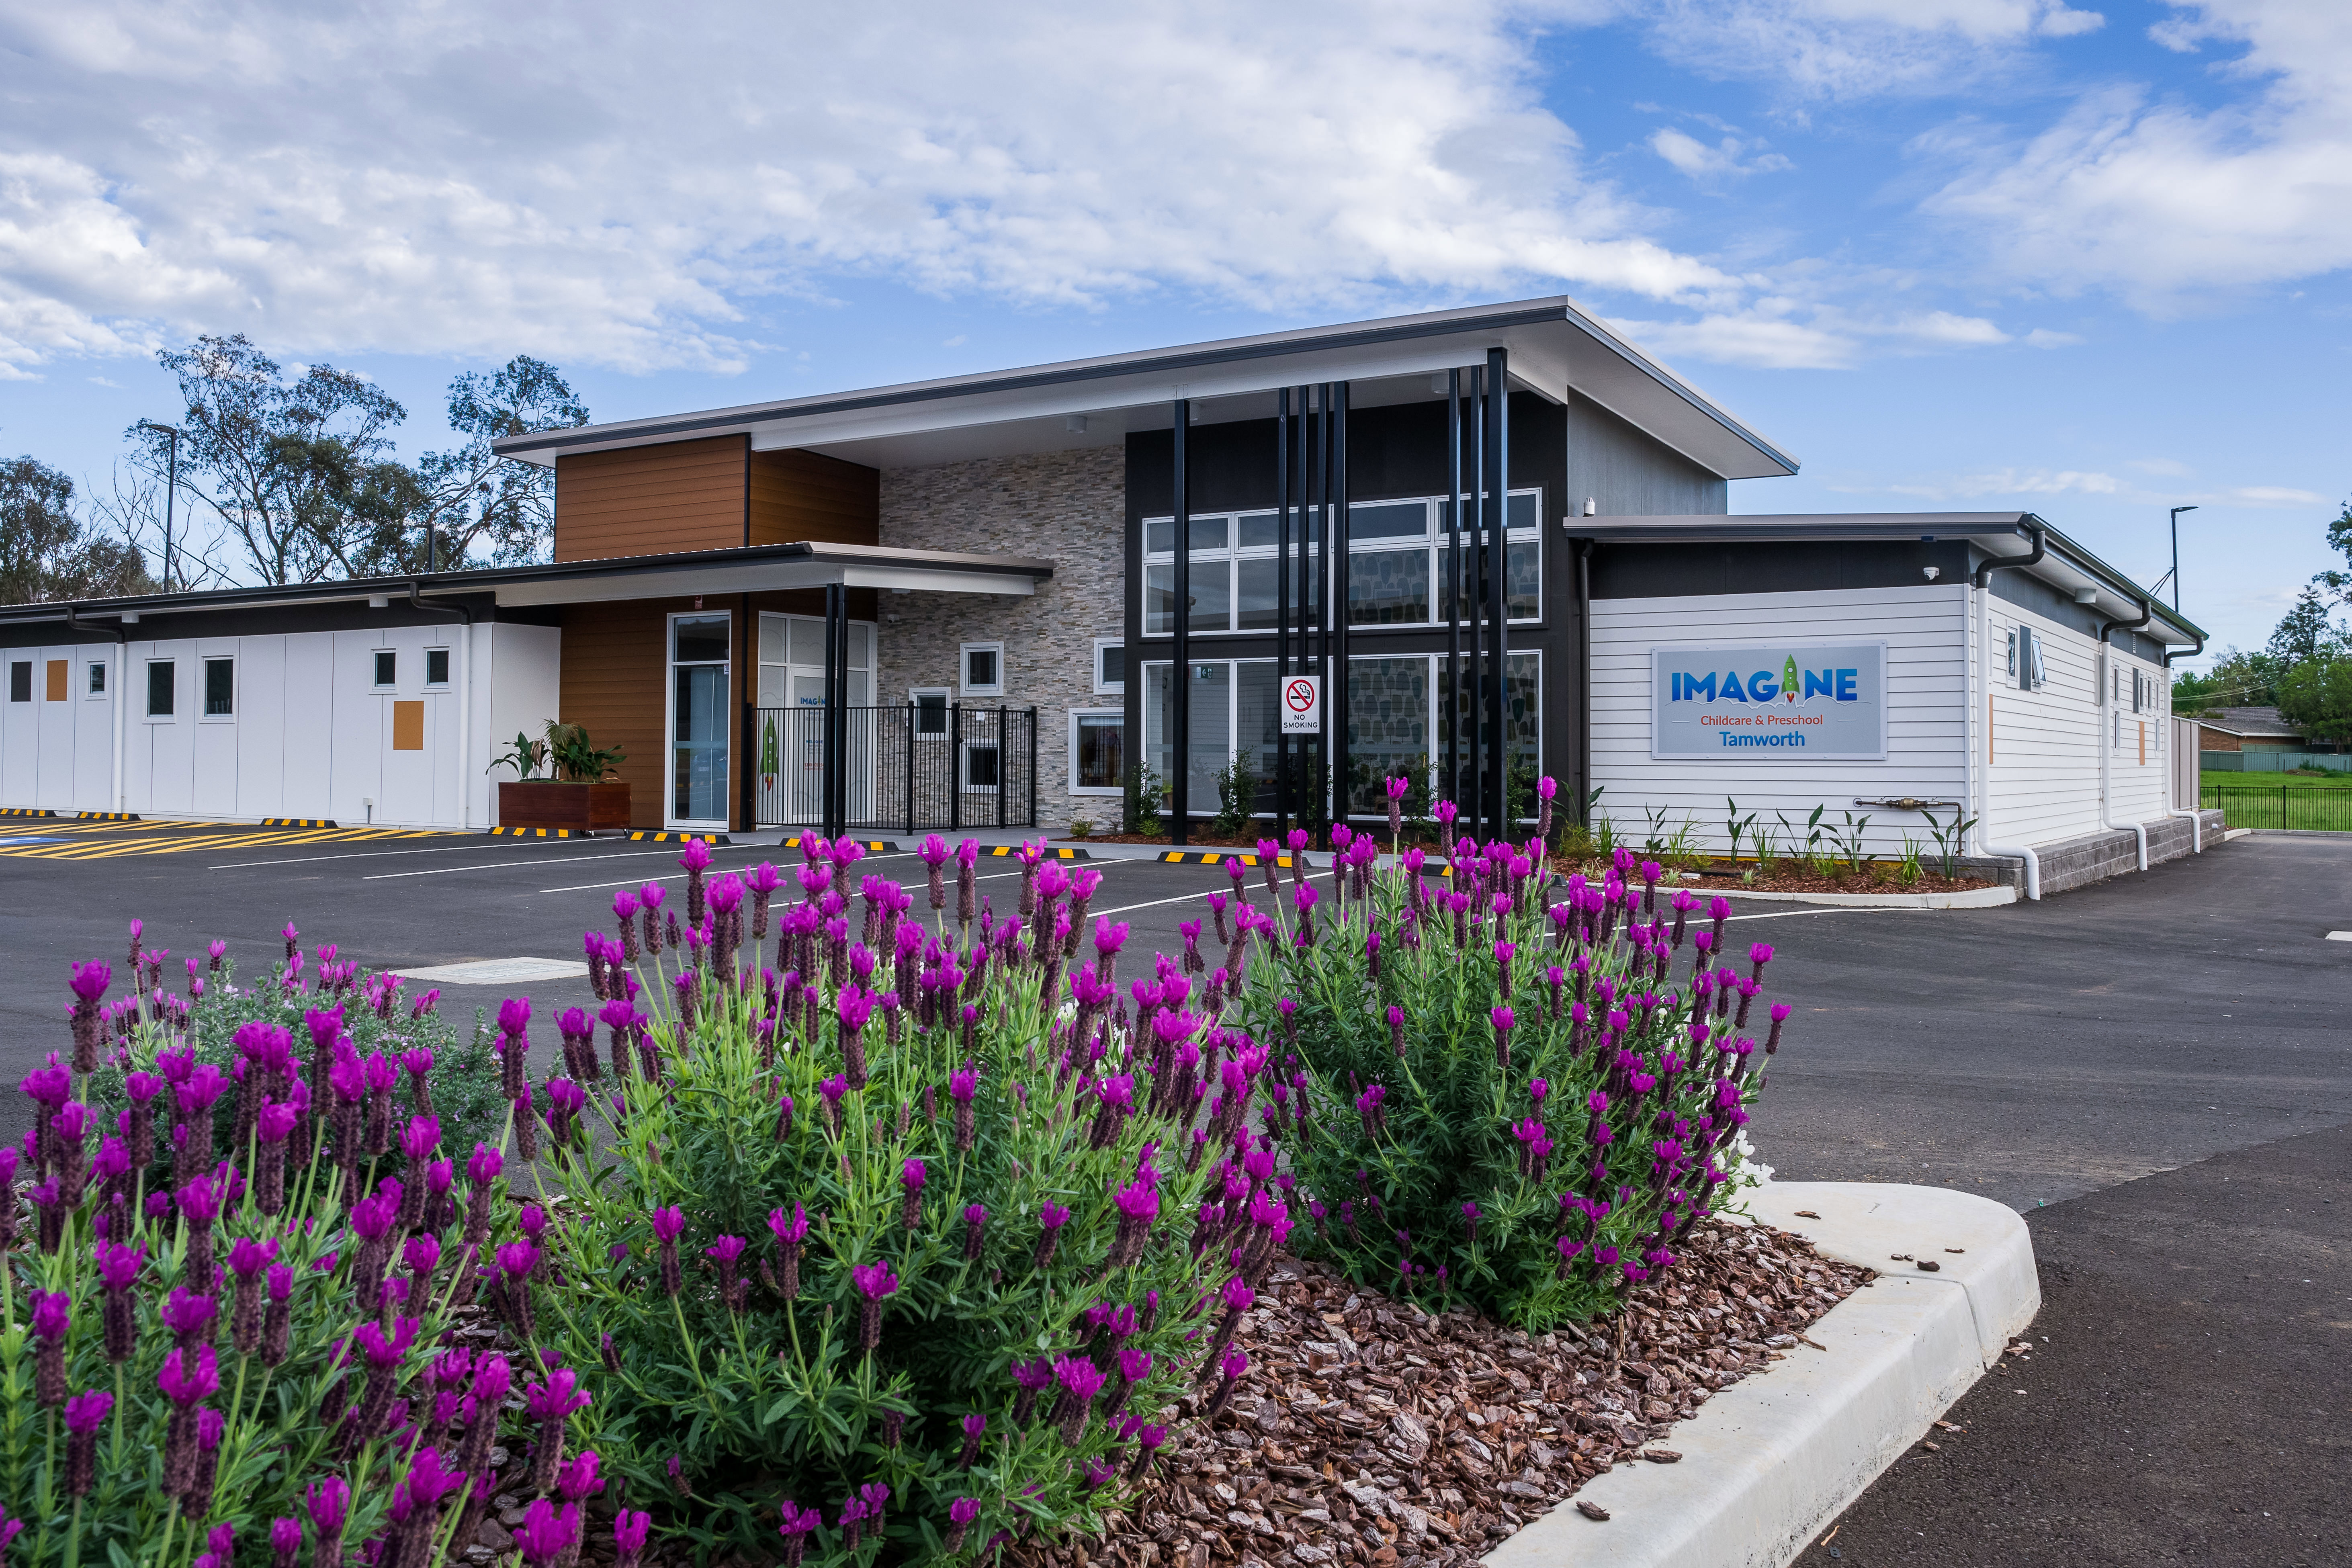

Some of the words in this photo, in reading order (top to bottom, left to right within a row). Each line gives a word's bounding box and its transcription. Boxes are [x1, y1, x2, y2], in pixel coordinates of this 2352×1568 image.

[1671, 654, 1858, 703] IMAGINE
[800, 696, 825, 705] IMAGIN
[1700, 715, 1752, 725] Childcare
[1755, 715, 1764, 725] &
[1768, 714, 1823, 725] Preschool
[1719, 731, 1805, 746] Tamworth
